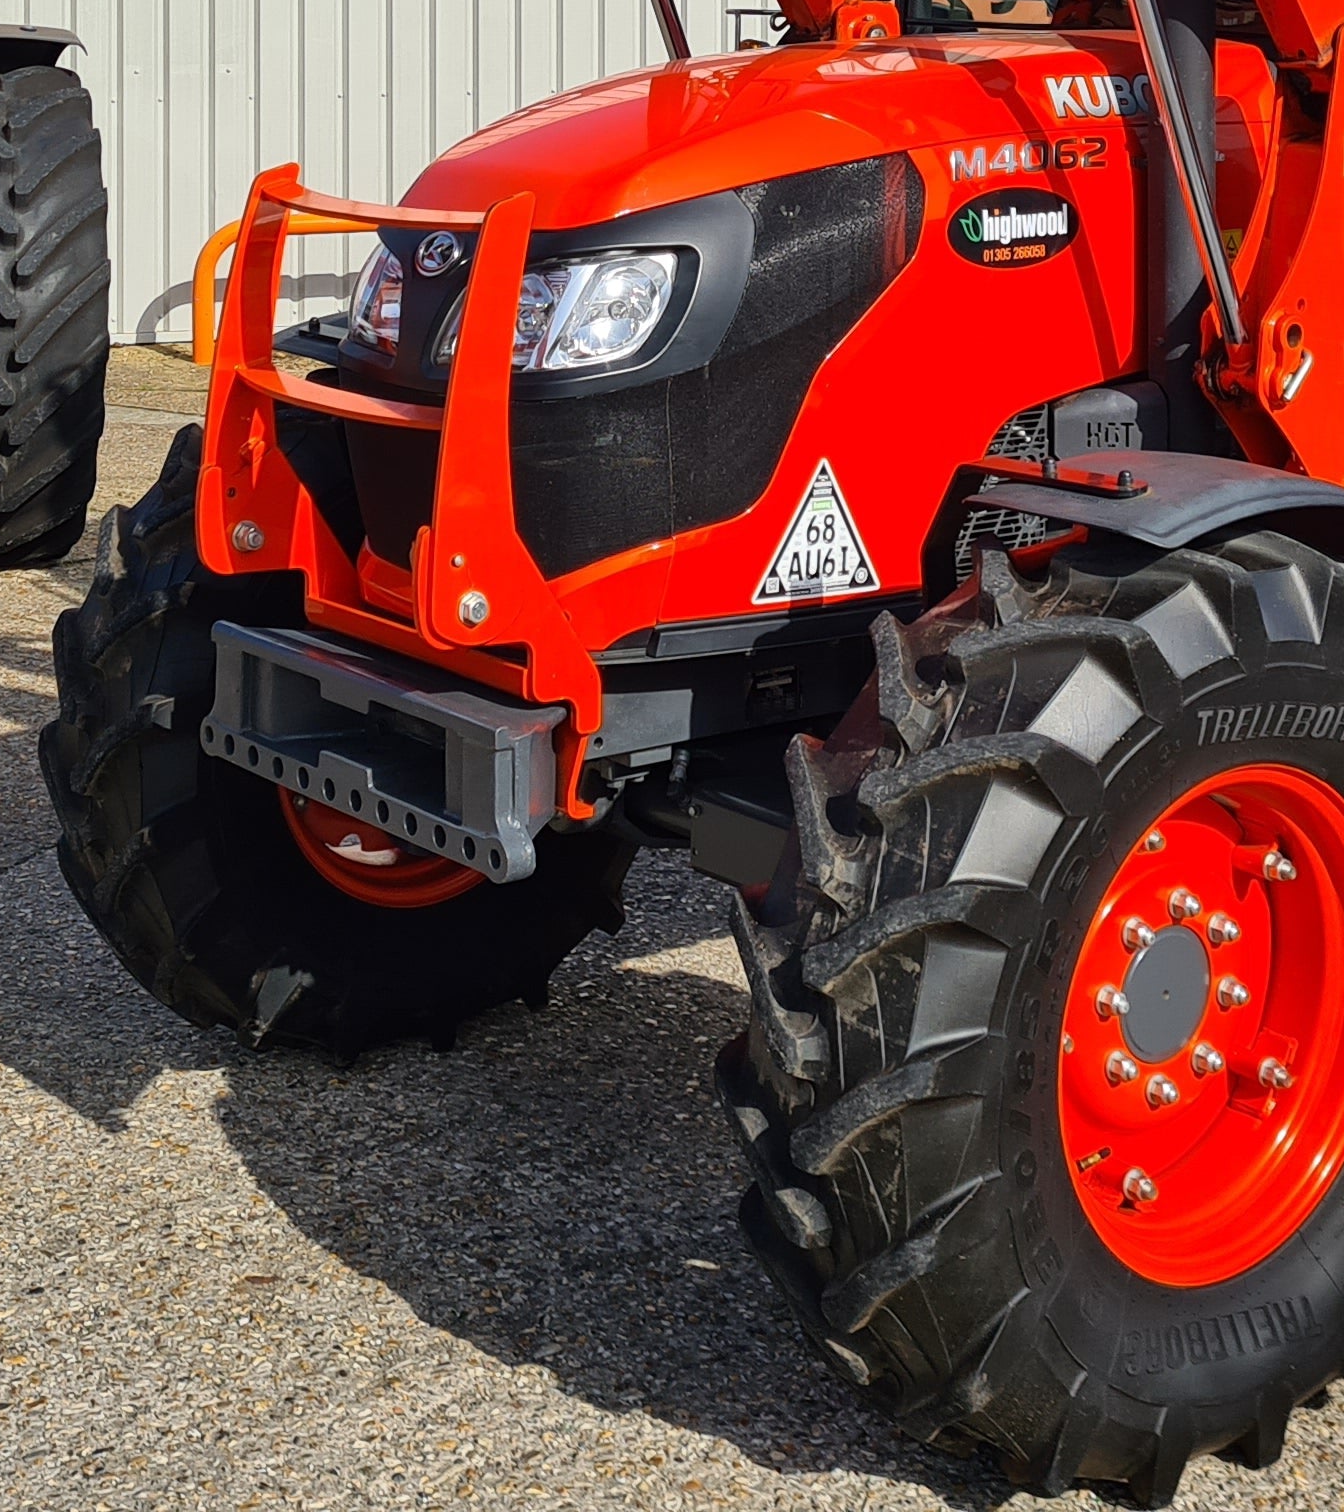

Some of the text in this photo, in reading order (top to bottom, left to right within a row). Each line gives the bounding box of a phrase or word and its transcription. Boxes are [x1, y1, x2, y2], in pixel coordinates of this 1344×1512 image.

[949, 136, 1108, 183] M4062
[982, 202, 1069, 246] highwood
[983, 243, 1047, 264] 01305 266058
[1087, 422, 1136, 448] HOT
[806, 513, 836, 546] 68
